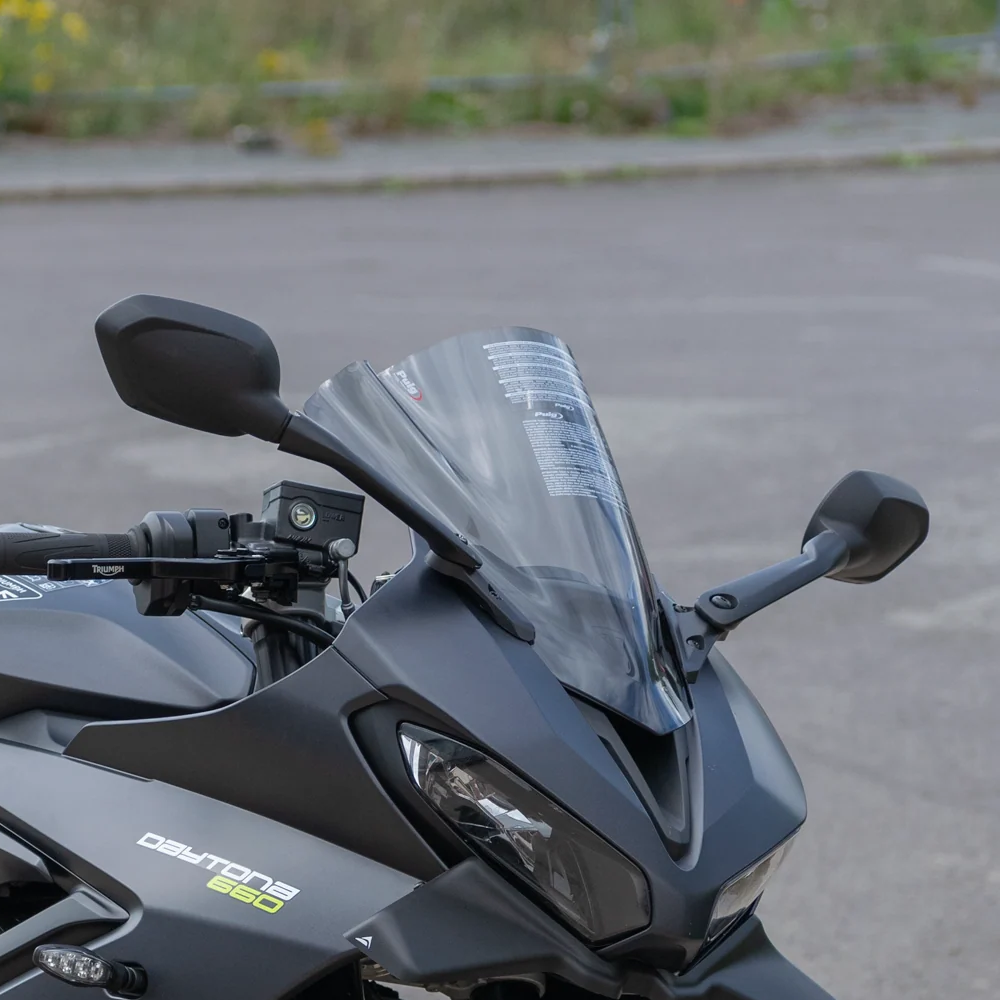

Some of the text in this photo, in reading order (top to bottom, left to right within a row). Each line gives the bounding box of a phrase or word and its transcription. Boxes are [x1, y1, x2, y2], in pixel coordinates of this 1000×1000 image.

[395, 369, 419, 396] Puig
[92, 565, 125, 576] TRIUMPH
[206, 875, 284, 914] 660
